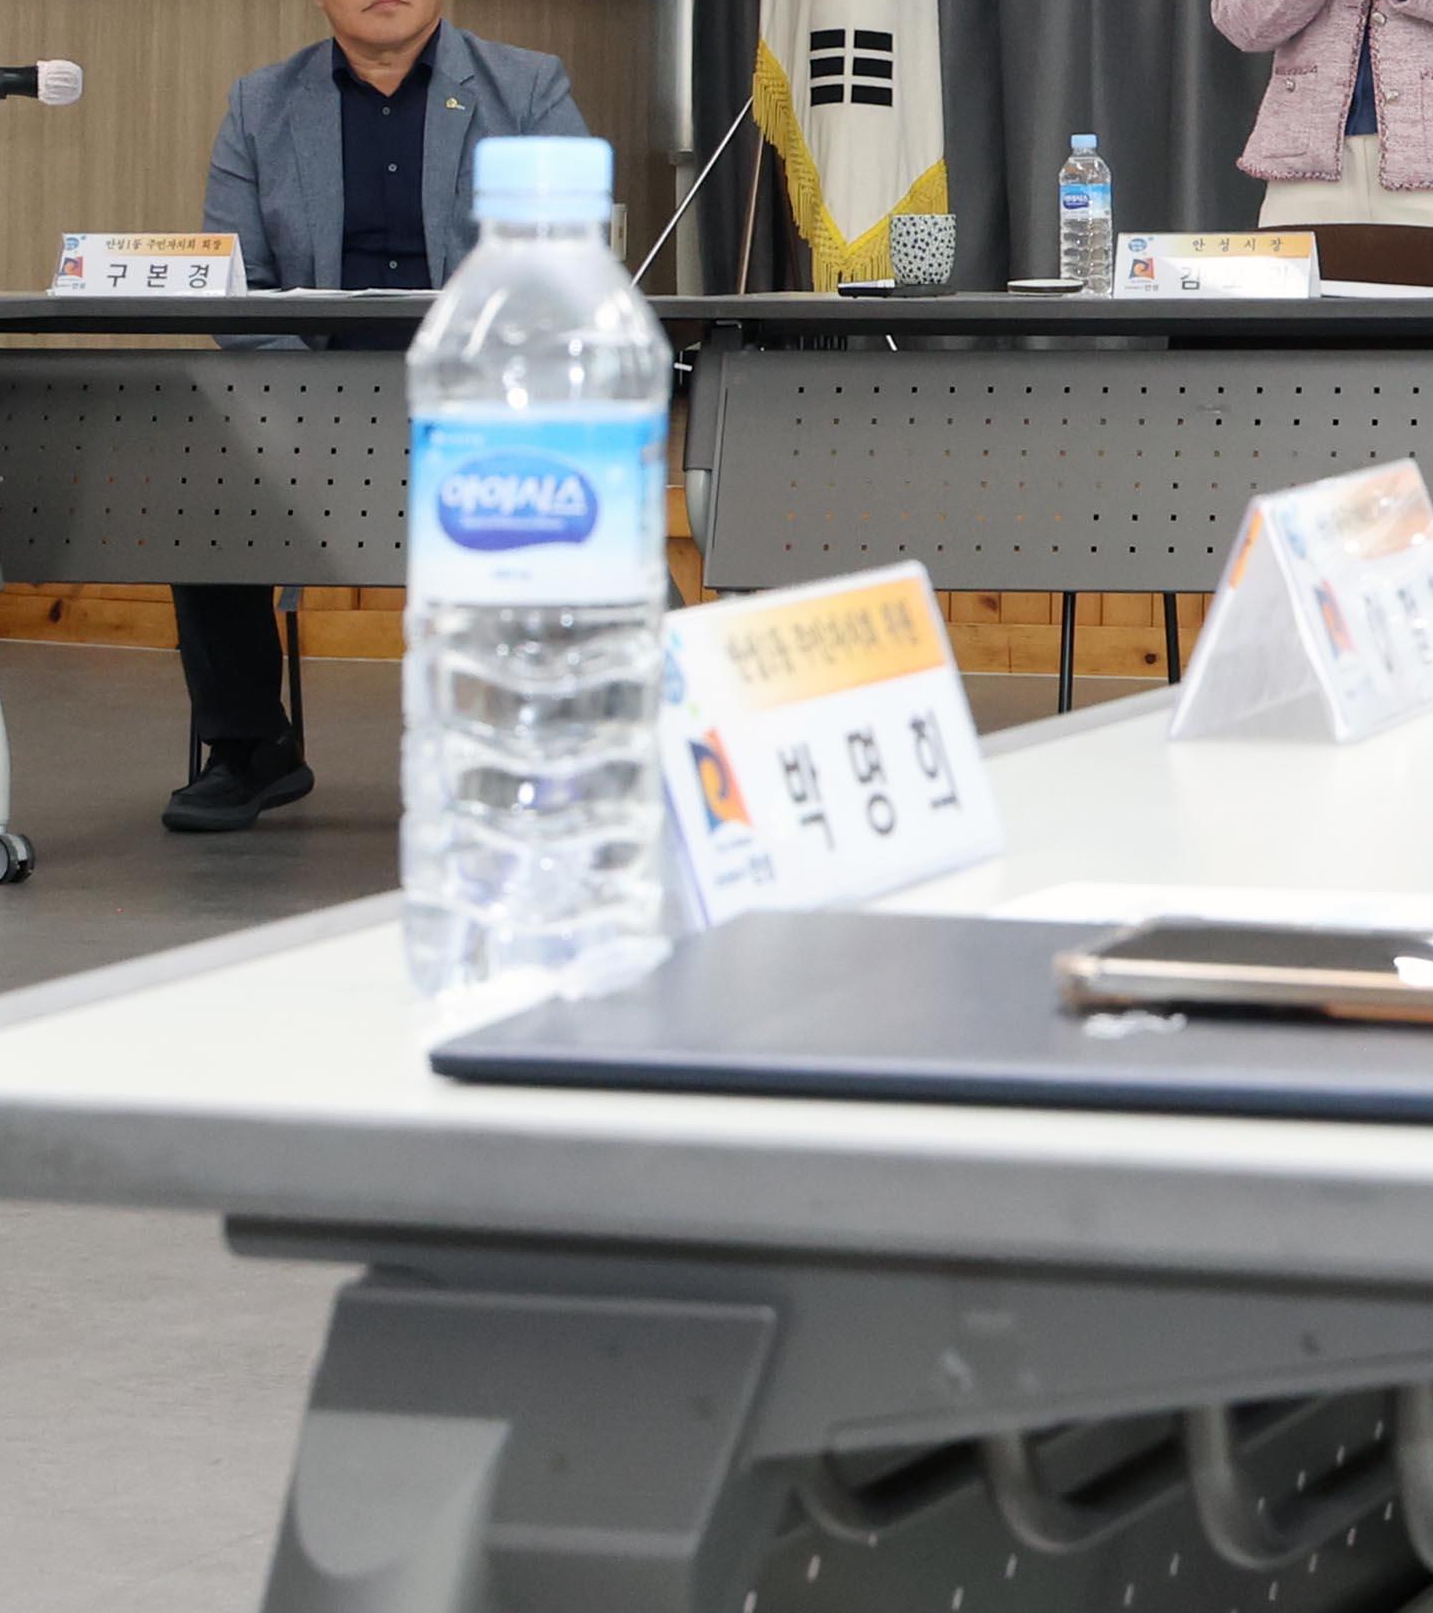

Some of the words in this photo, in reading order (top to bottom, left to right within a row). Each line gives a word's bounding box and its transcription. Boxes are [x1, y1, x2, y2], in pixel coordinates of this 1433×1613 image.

[107, 263, 210, 289] 구본경
[439, 473, 588, 517] 아이시스
[777, 705, 960, 854] 박명희
